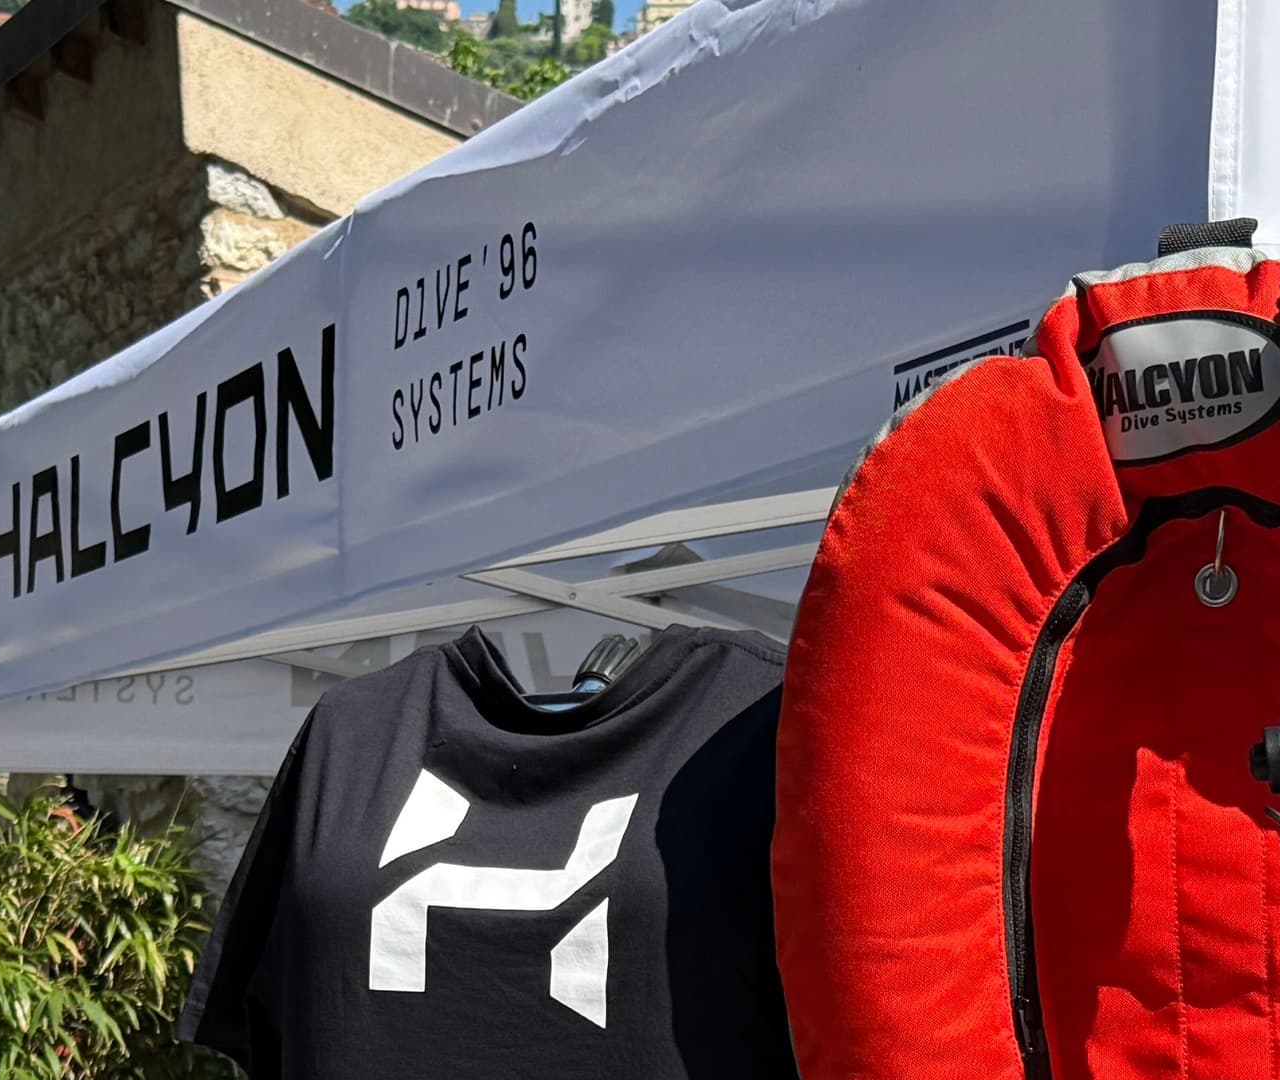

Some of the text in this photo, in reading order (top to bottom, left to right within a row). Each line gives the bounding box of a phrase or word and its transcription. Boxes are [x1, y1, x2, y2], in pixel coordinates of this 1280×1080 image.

[391, 333, 528, 451] SYSTEMS
[1121, 401, 1243, 433] Dive Systems
